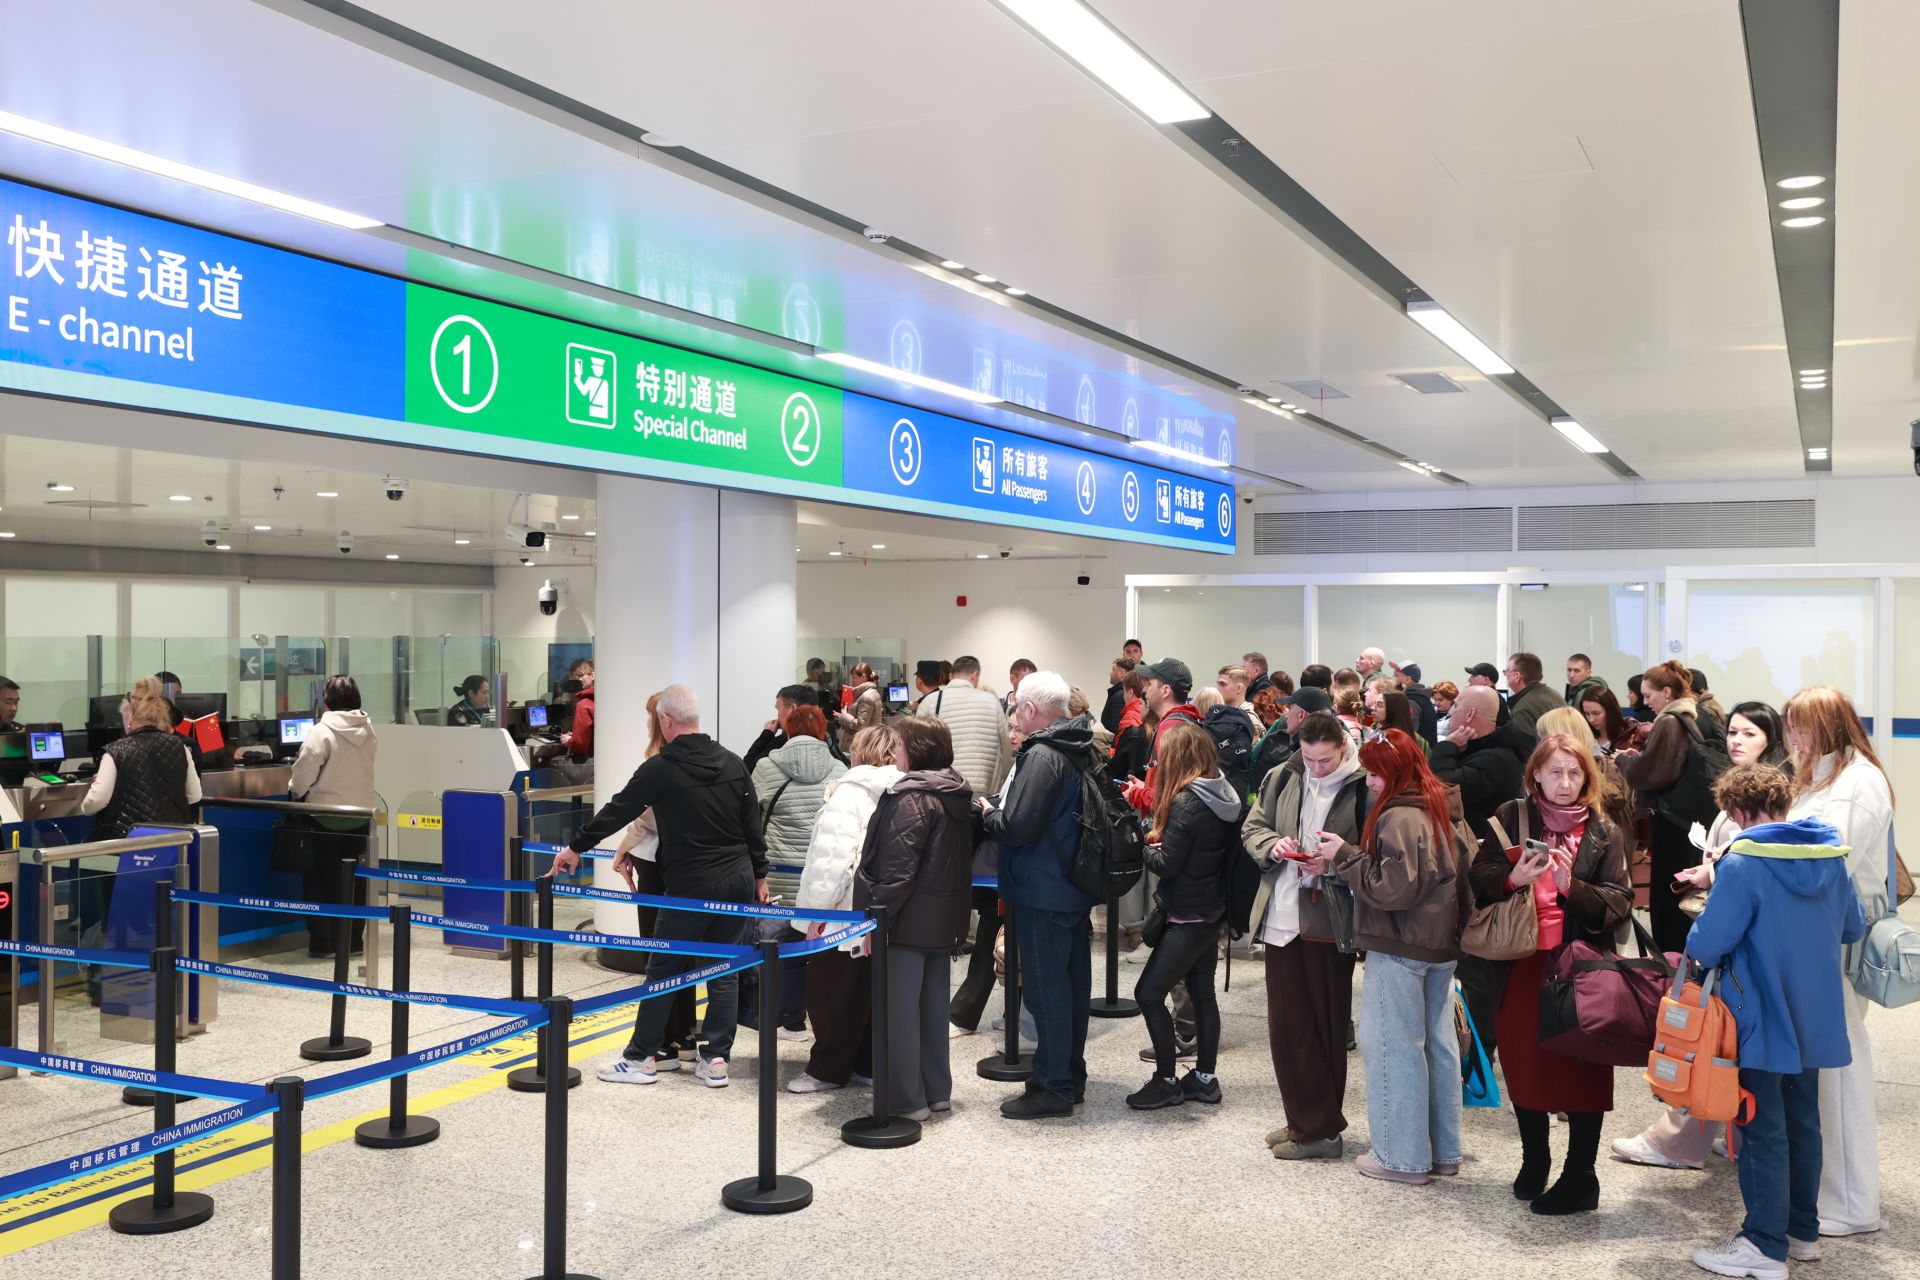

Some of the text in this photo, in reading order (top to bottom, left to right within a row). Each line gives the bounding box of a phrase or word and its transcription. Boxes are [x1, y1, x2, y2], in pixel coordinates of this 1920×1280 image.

[7, 214, 243, 320] 快捷通道
[59, 306, 195, 362] channel
[636, 361, 737, 418] 特别通道
[633, 409, 747, 451] Special Channel
[1002, 446, 1048, 481] 所有旅客
[1002, 479, 1048, 504] All Passengers
[1174, 485, 1205, 512] 所有旅客
[1182, 512, 1205, 530] Passengers
[422, 875, 436, 883] CHINA
[586, 888, 600, 897] CHINA
[601, 890, 632, 901] IMMIGRATION
[274, 901, 289, 910] CHINA
[289, 902, 320, 911] IMMIGRATION
[743, 905, 759, 914] CHINA
[760, 907, 795, 916] IMMIGRATION
[410, 913, 489, 932] 移民管理 CHINA IMMIGRATION
[25, 944, 41, 953] CHINA
[41, 946, 75, 957] IMMIGRATION
[568, 933, 670, 949] 中国移民管理 CHINA IMMIGRATION
[215, 966, 232, 976] CHINA
[232, 968, 269, 981] IMMIGRATION
[685, 971, 701, 983] CHINA
[701, 962, 731, 978] IMMIGRATION
[339, 984, 380, 996] 中国移民管理
[403, 993, 447, 1004] IMMIGRATION
[419, 1041, 463, 1062] 中国移民管理
[470, 1031, 490, 1047] CHINA
[490, 1018, 528, 1041] IMMIGRATION
[40, 1055, 157, 1083] 中国移民管理 CHINA IMMIGRATION
[69, 1140, 140, 1173] 中国移民管理
[151, 1128, 182, 1147] CHINA
[183, 1107, 243, 1137] IMMIGRATION
